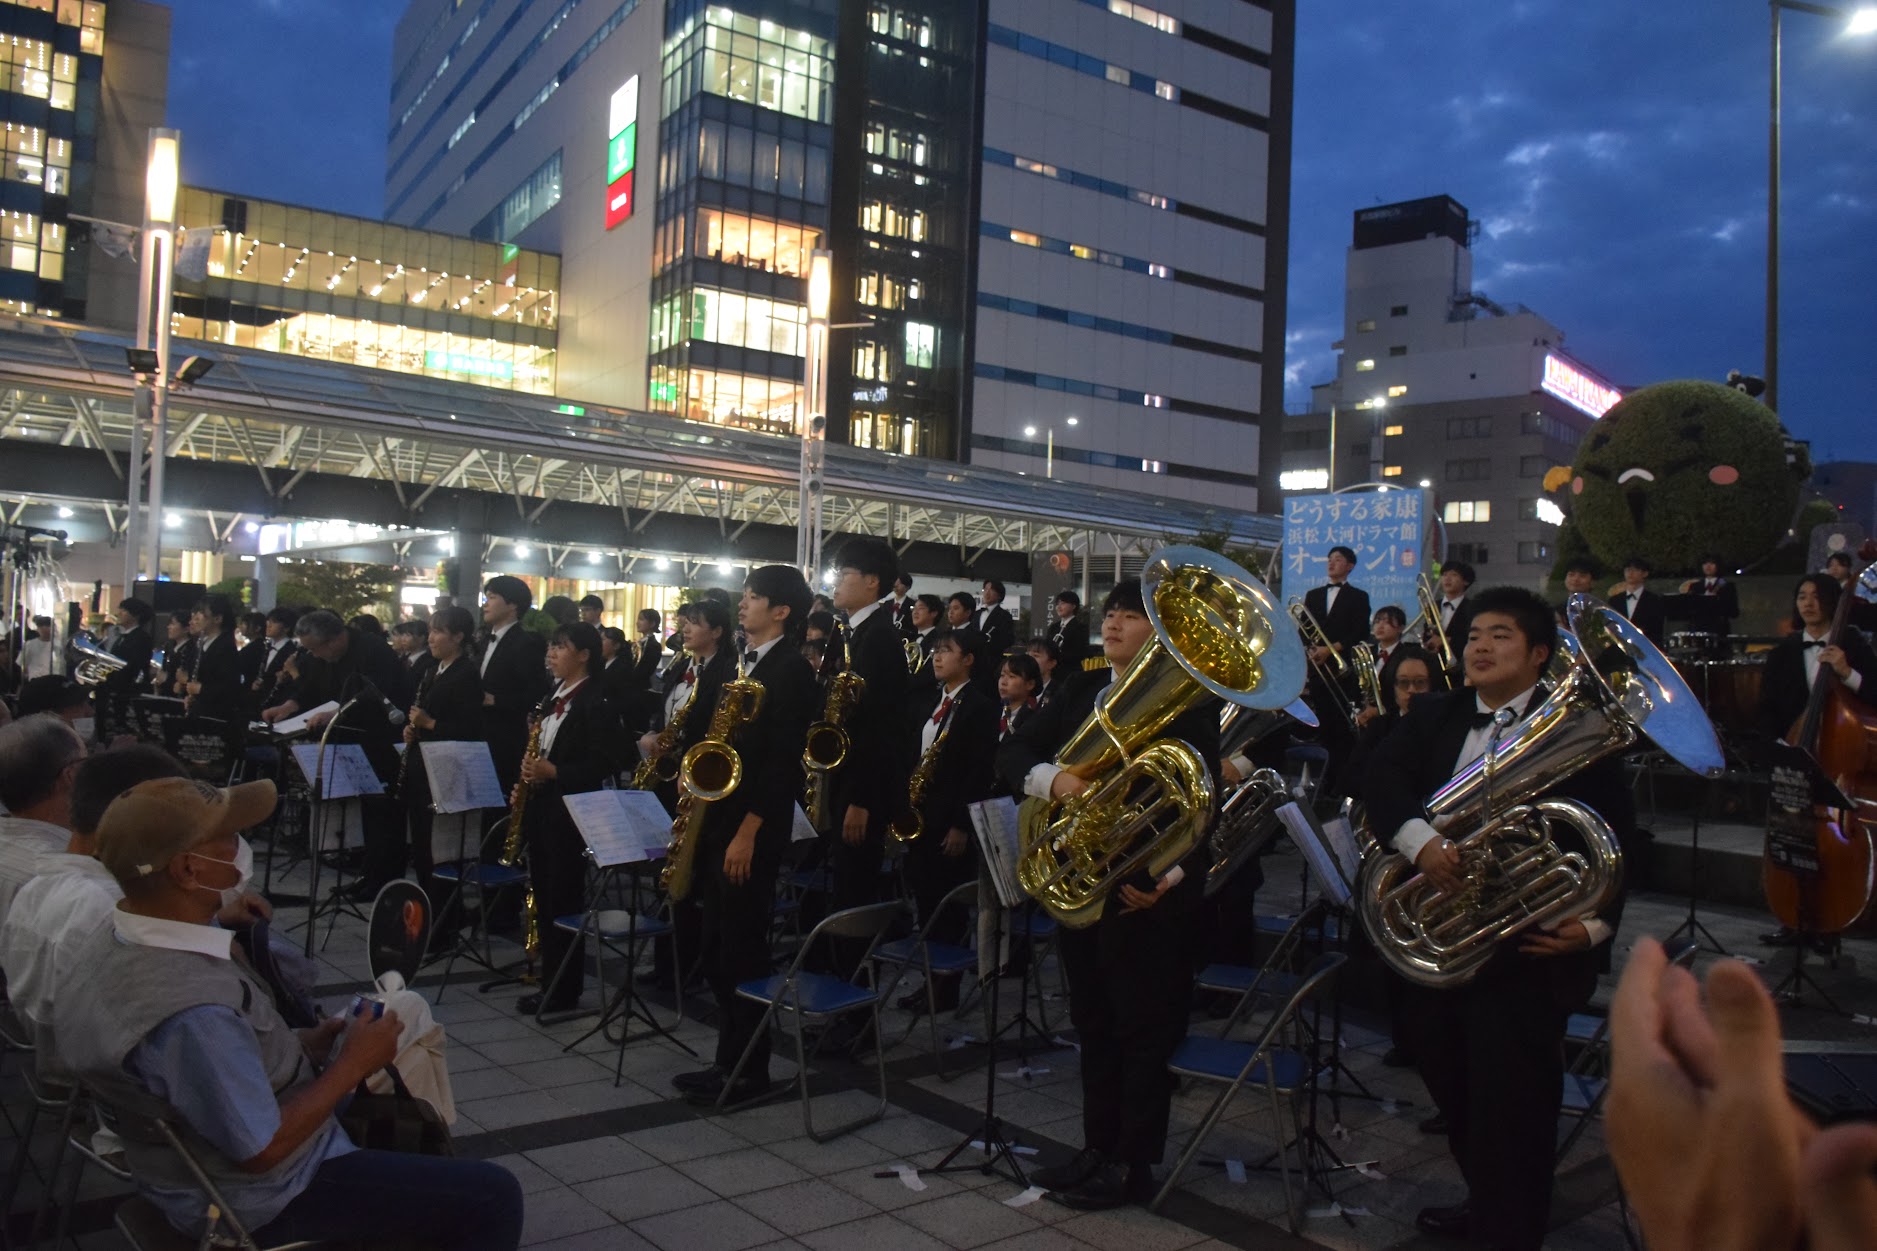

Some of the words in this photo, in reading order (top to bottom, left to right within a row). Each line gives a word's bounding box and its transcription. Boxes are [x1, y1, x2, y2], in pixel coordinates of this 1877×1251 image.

[1288, 494, 1418, 525] どうする家康
[1288, 544, 1397, 575] オーン!
